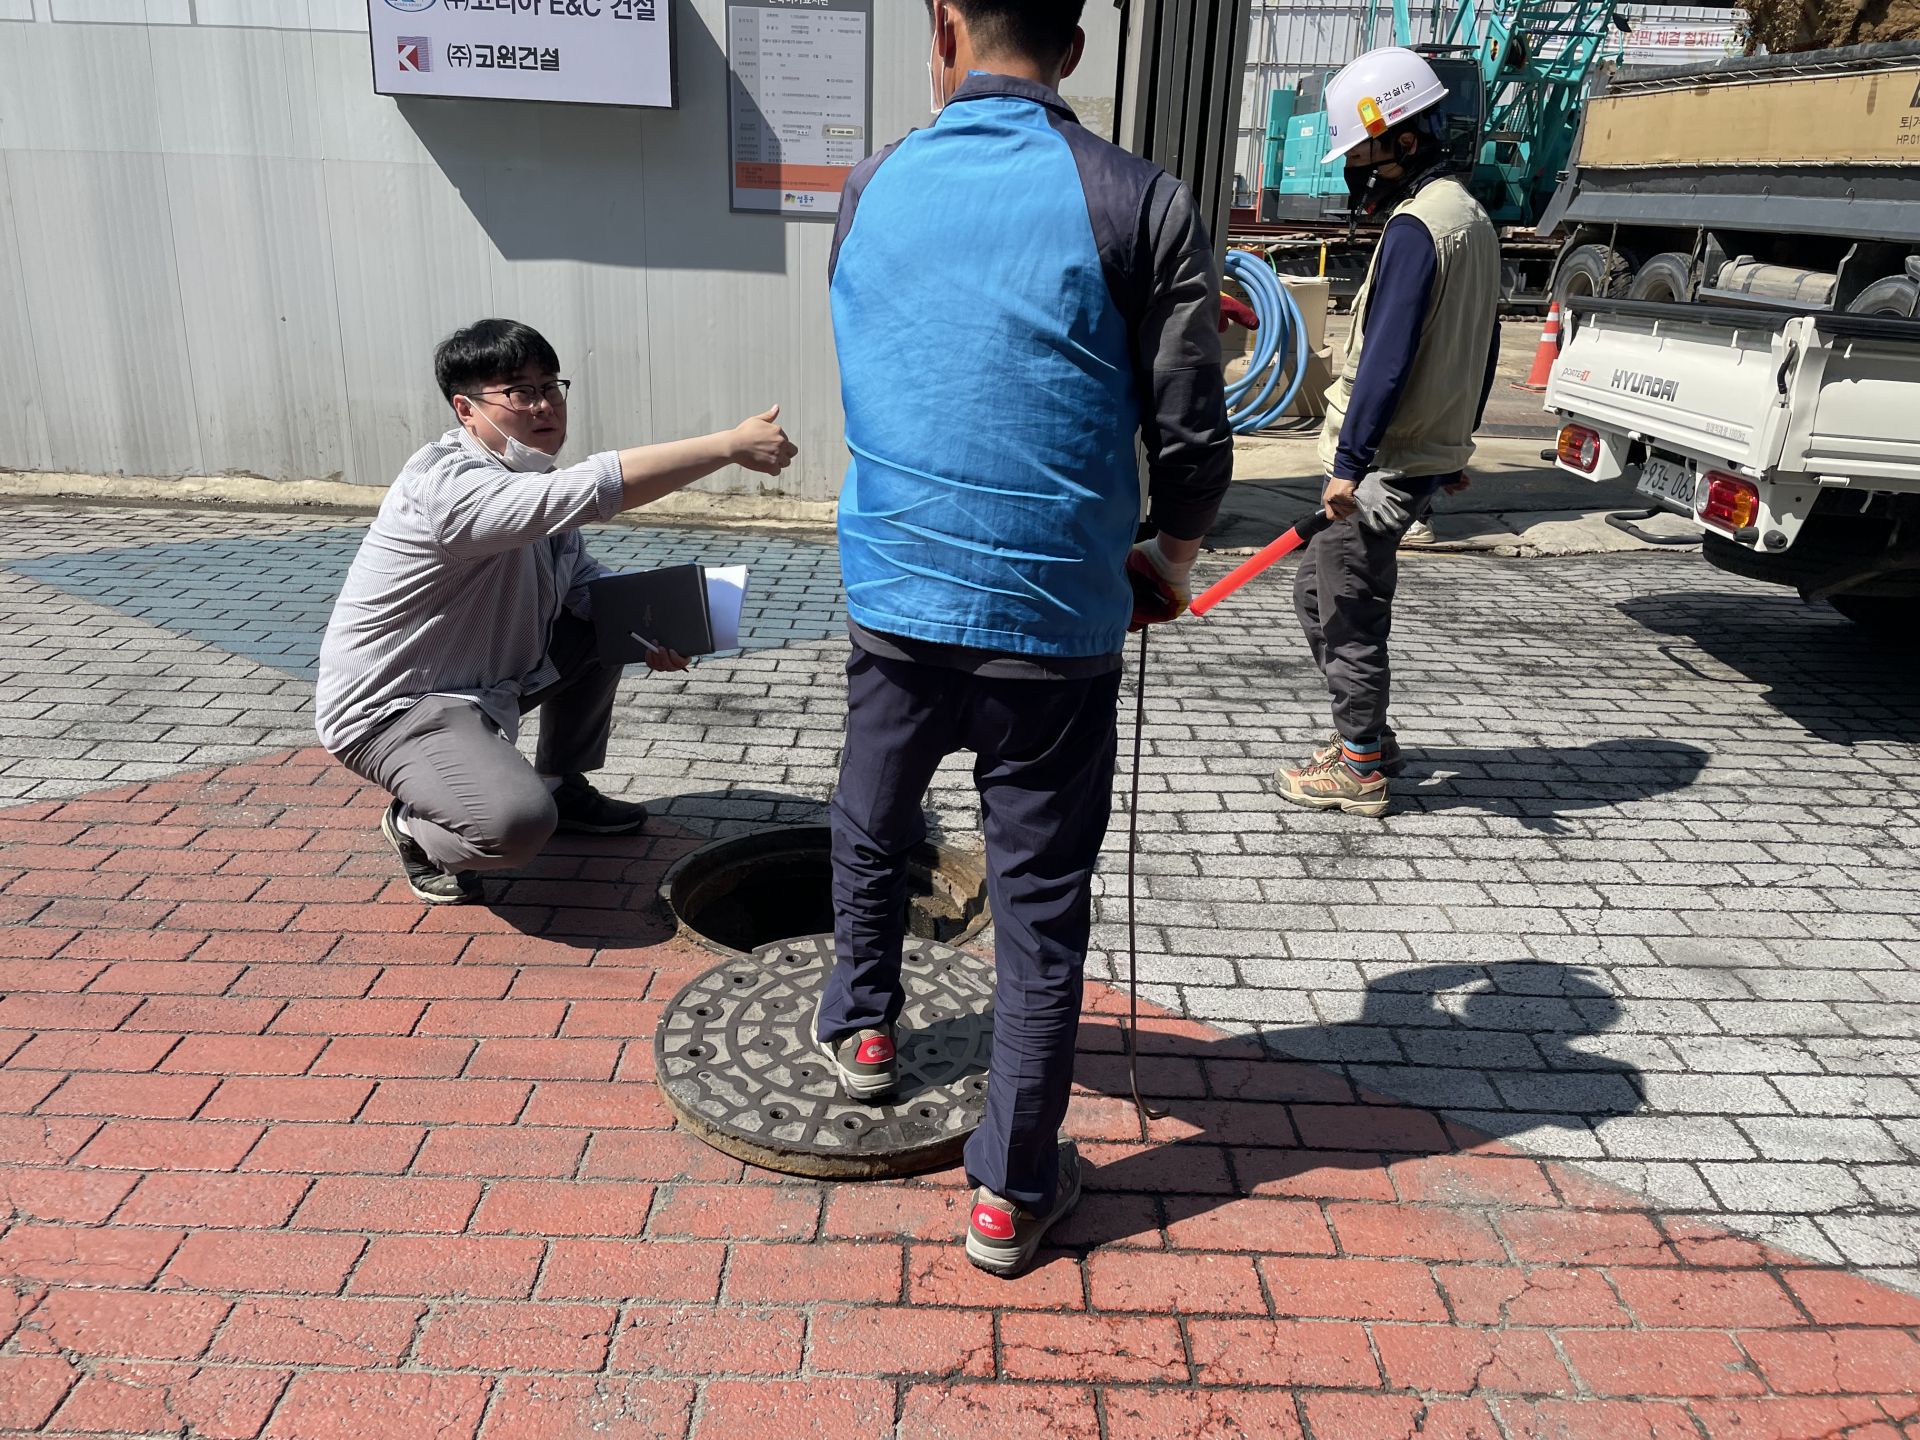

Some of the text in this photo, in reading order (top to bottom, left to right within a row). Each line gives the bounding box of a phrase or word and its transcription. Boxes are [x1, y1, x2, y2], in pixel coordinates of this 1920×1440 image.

[550, 0, 601, 16] E&C
[610, 0, 655, 21] 건설
[446, 42, 560, 72] (주)고원건설
[1611, 368, 1680, 402] HYUNDAI
